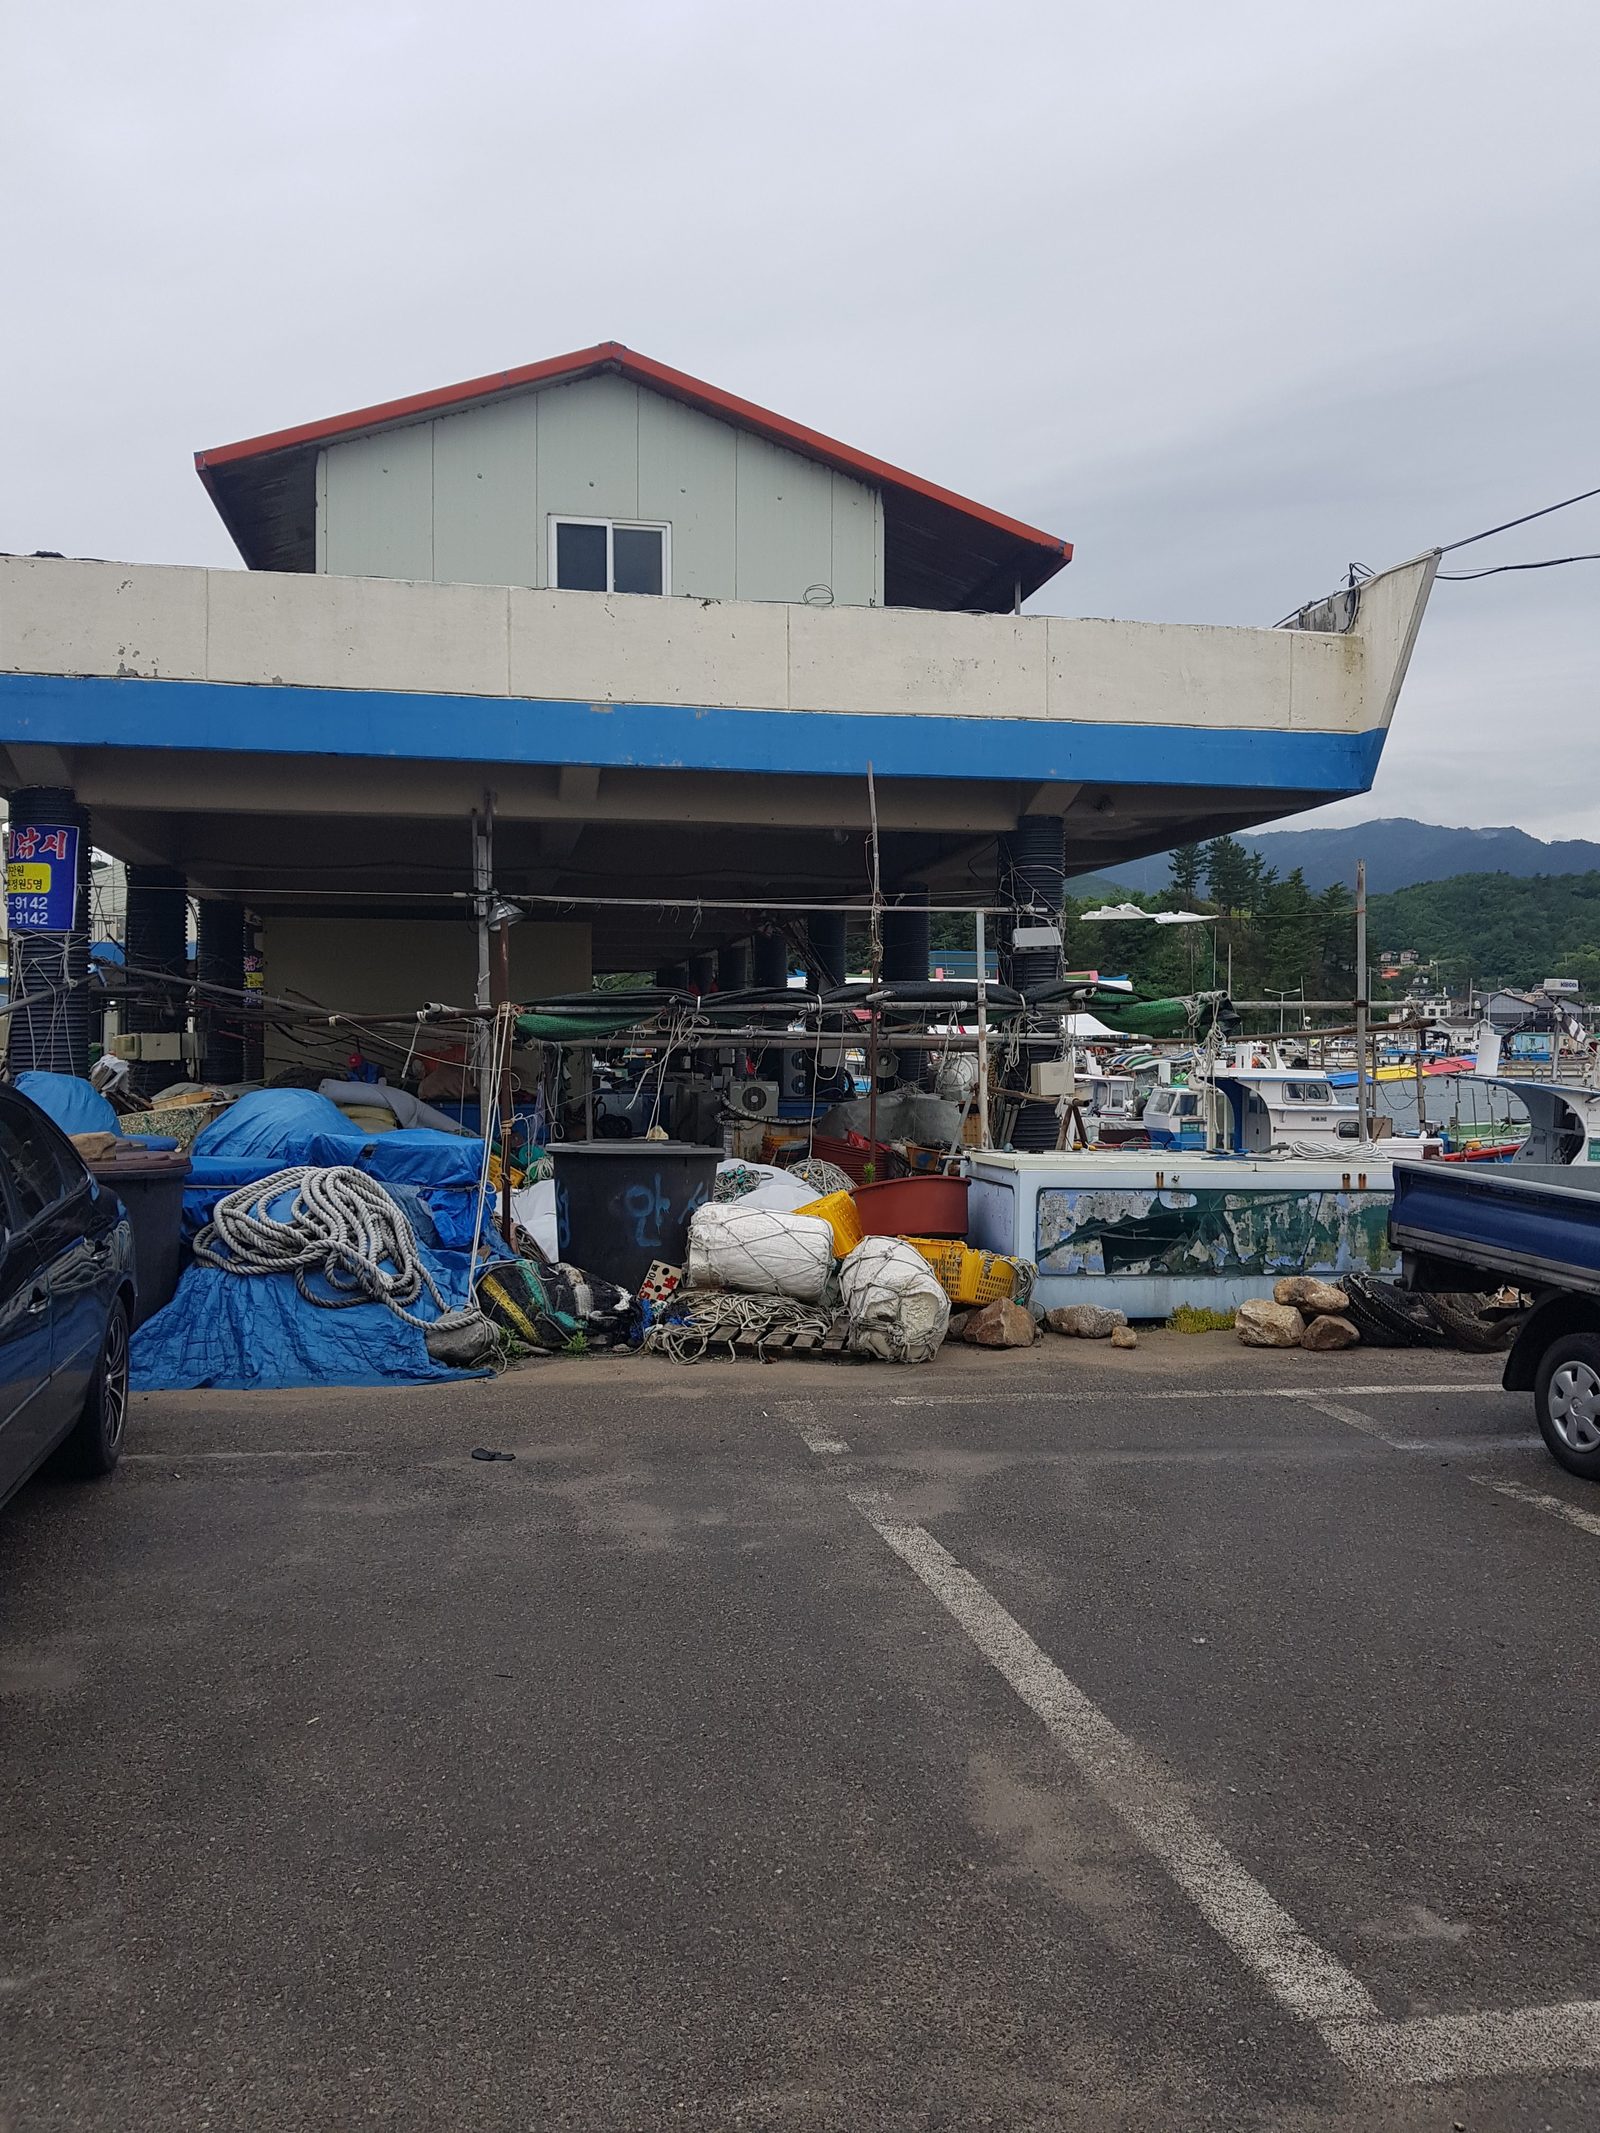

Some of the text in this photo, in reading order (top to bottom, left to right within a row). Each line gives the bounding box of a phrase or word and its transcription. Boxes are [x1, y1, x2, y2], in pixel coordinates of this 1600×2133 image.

[7, 865, 25, 877] 만원
[7, 896, 48, 910] -9142
[7, 911, 49, 925] -9142
